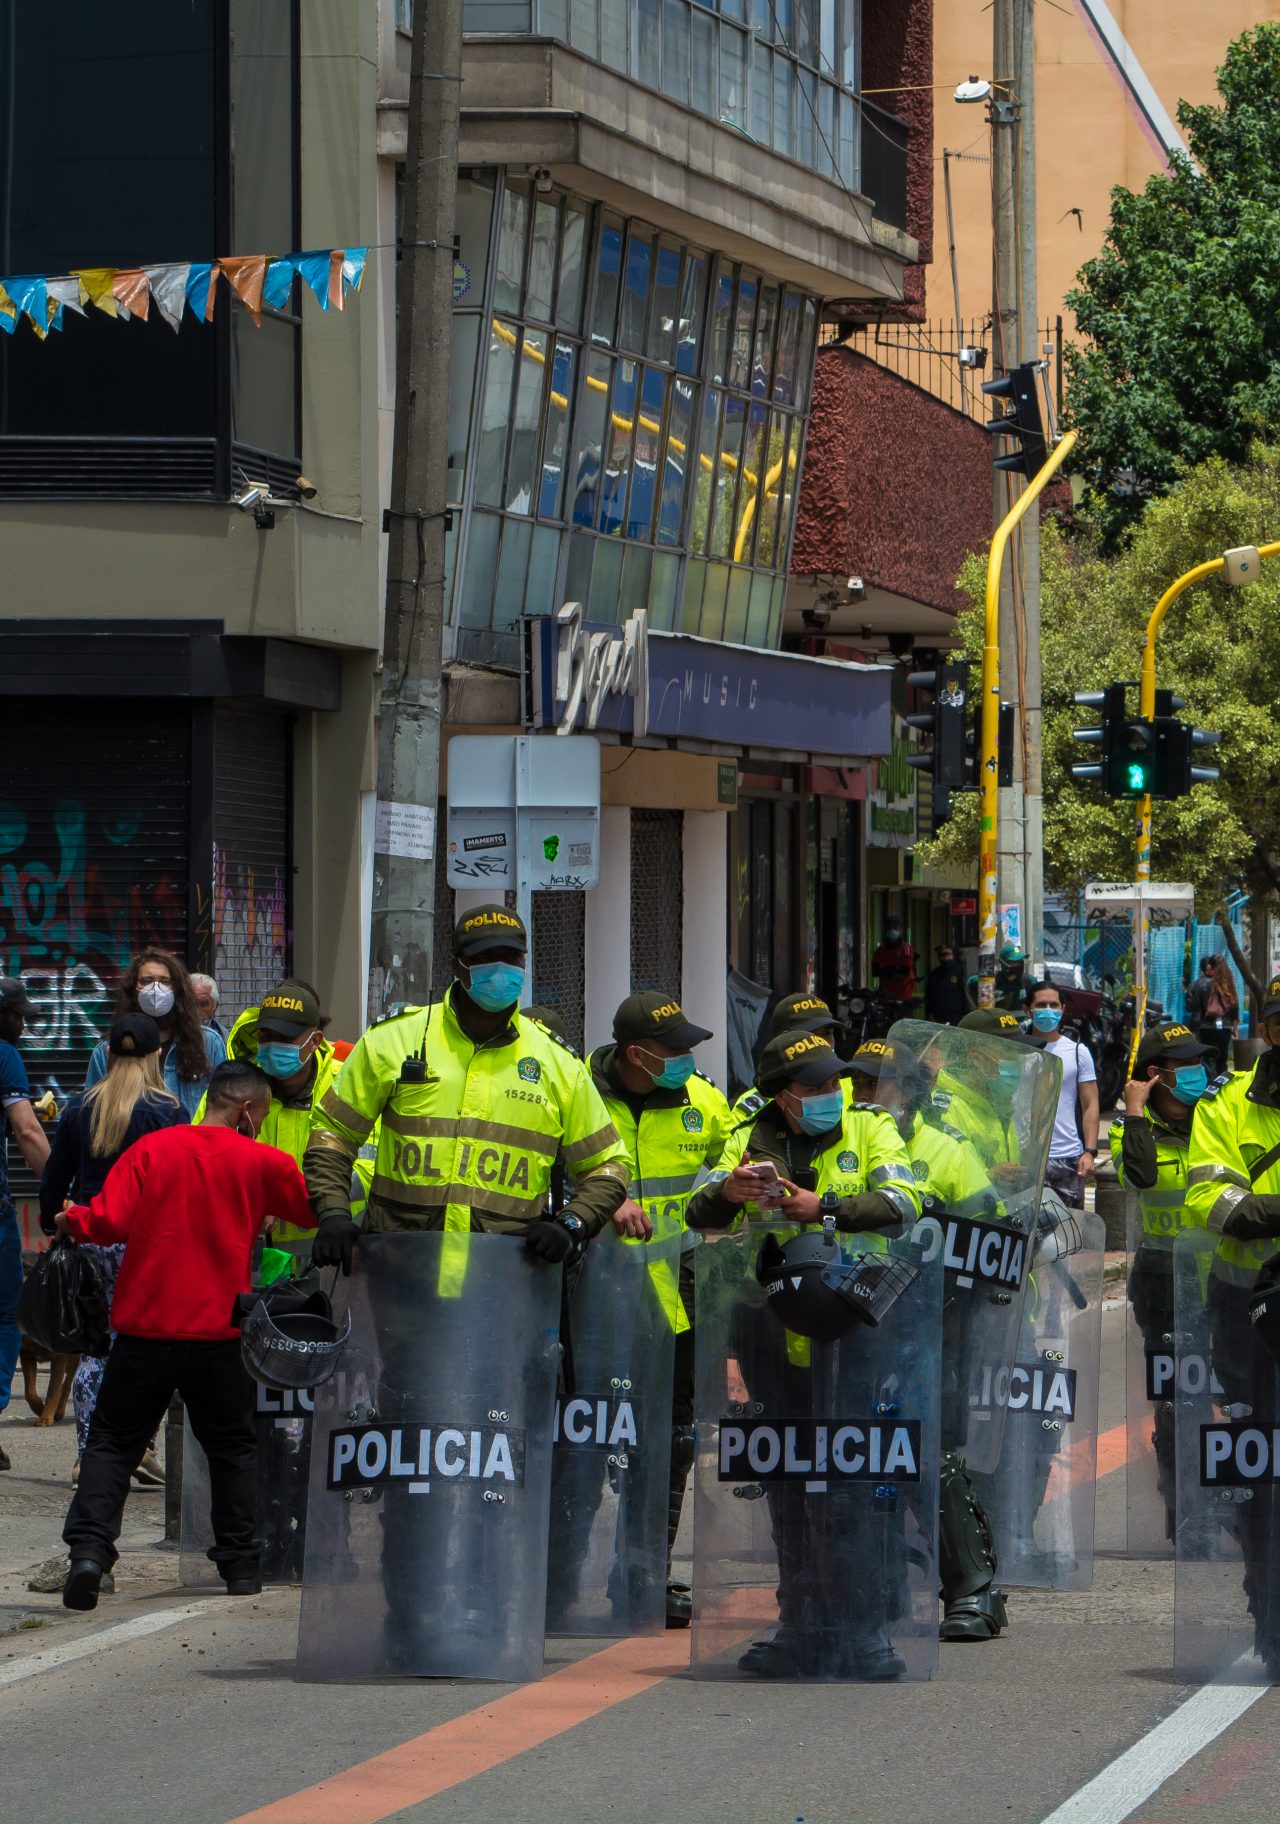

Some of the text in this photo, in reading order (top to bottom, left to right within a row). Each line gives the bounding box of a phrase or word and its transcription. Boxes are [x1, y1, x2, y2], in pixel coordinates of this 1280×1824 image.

[683, 669, 758, 710] MUSIC
[463, 911, 521, 932] POLICIA
[332, 1428, 515, 1483] POLICIA
[720, 1425, 918, 1475] POLICIA
